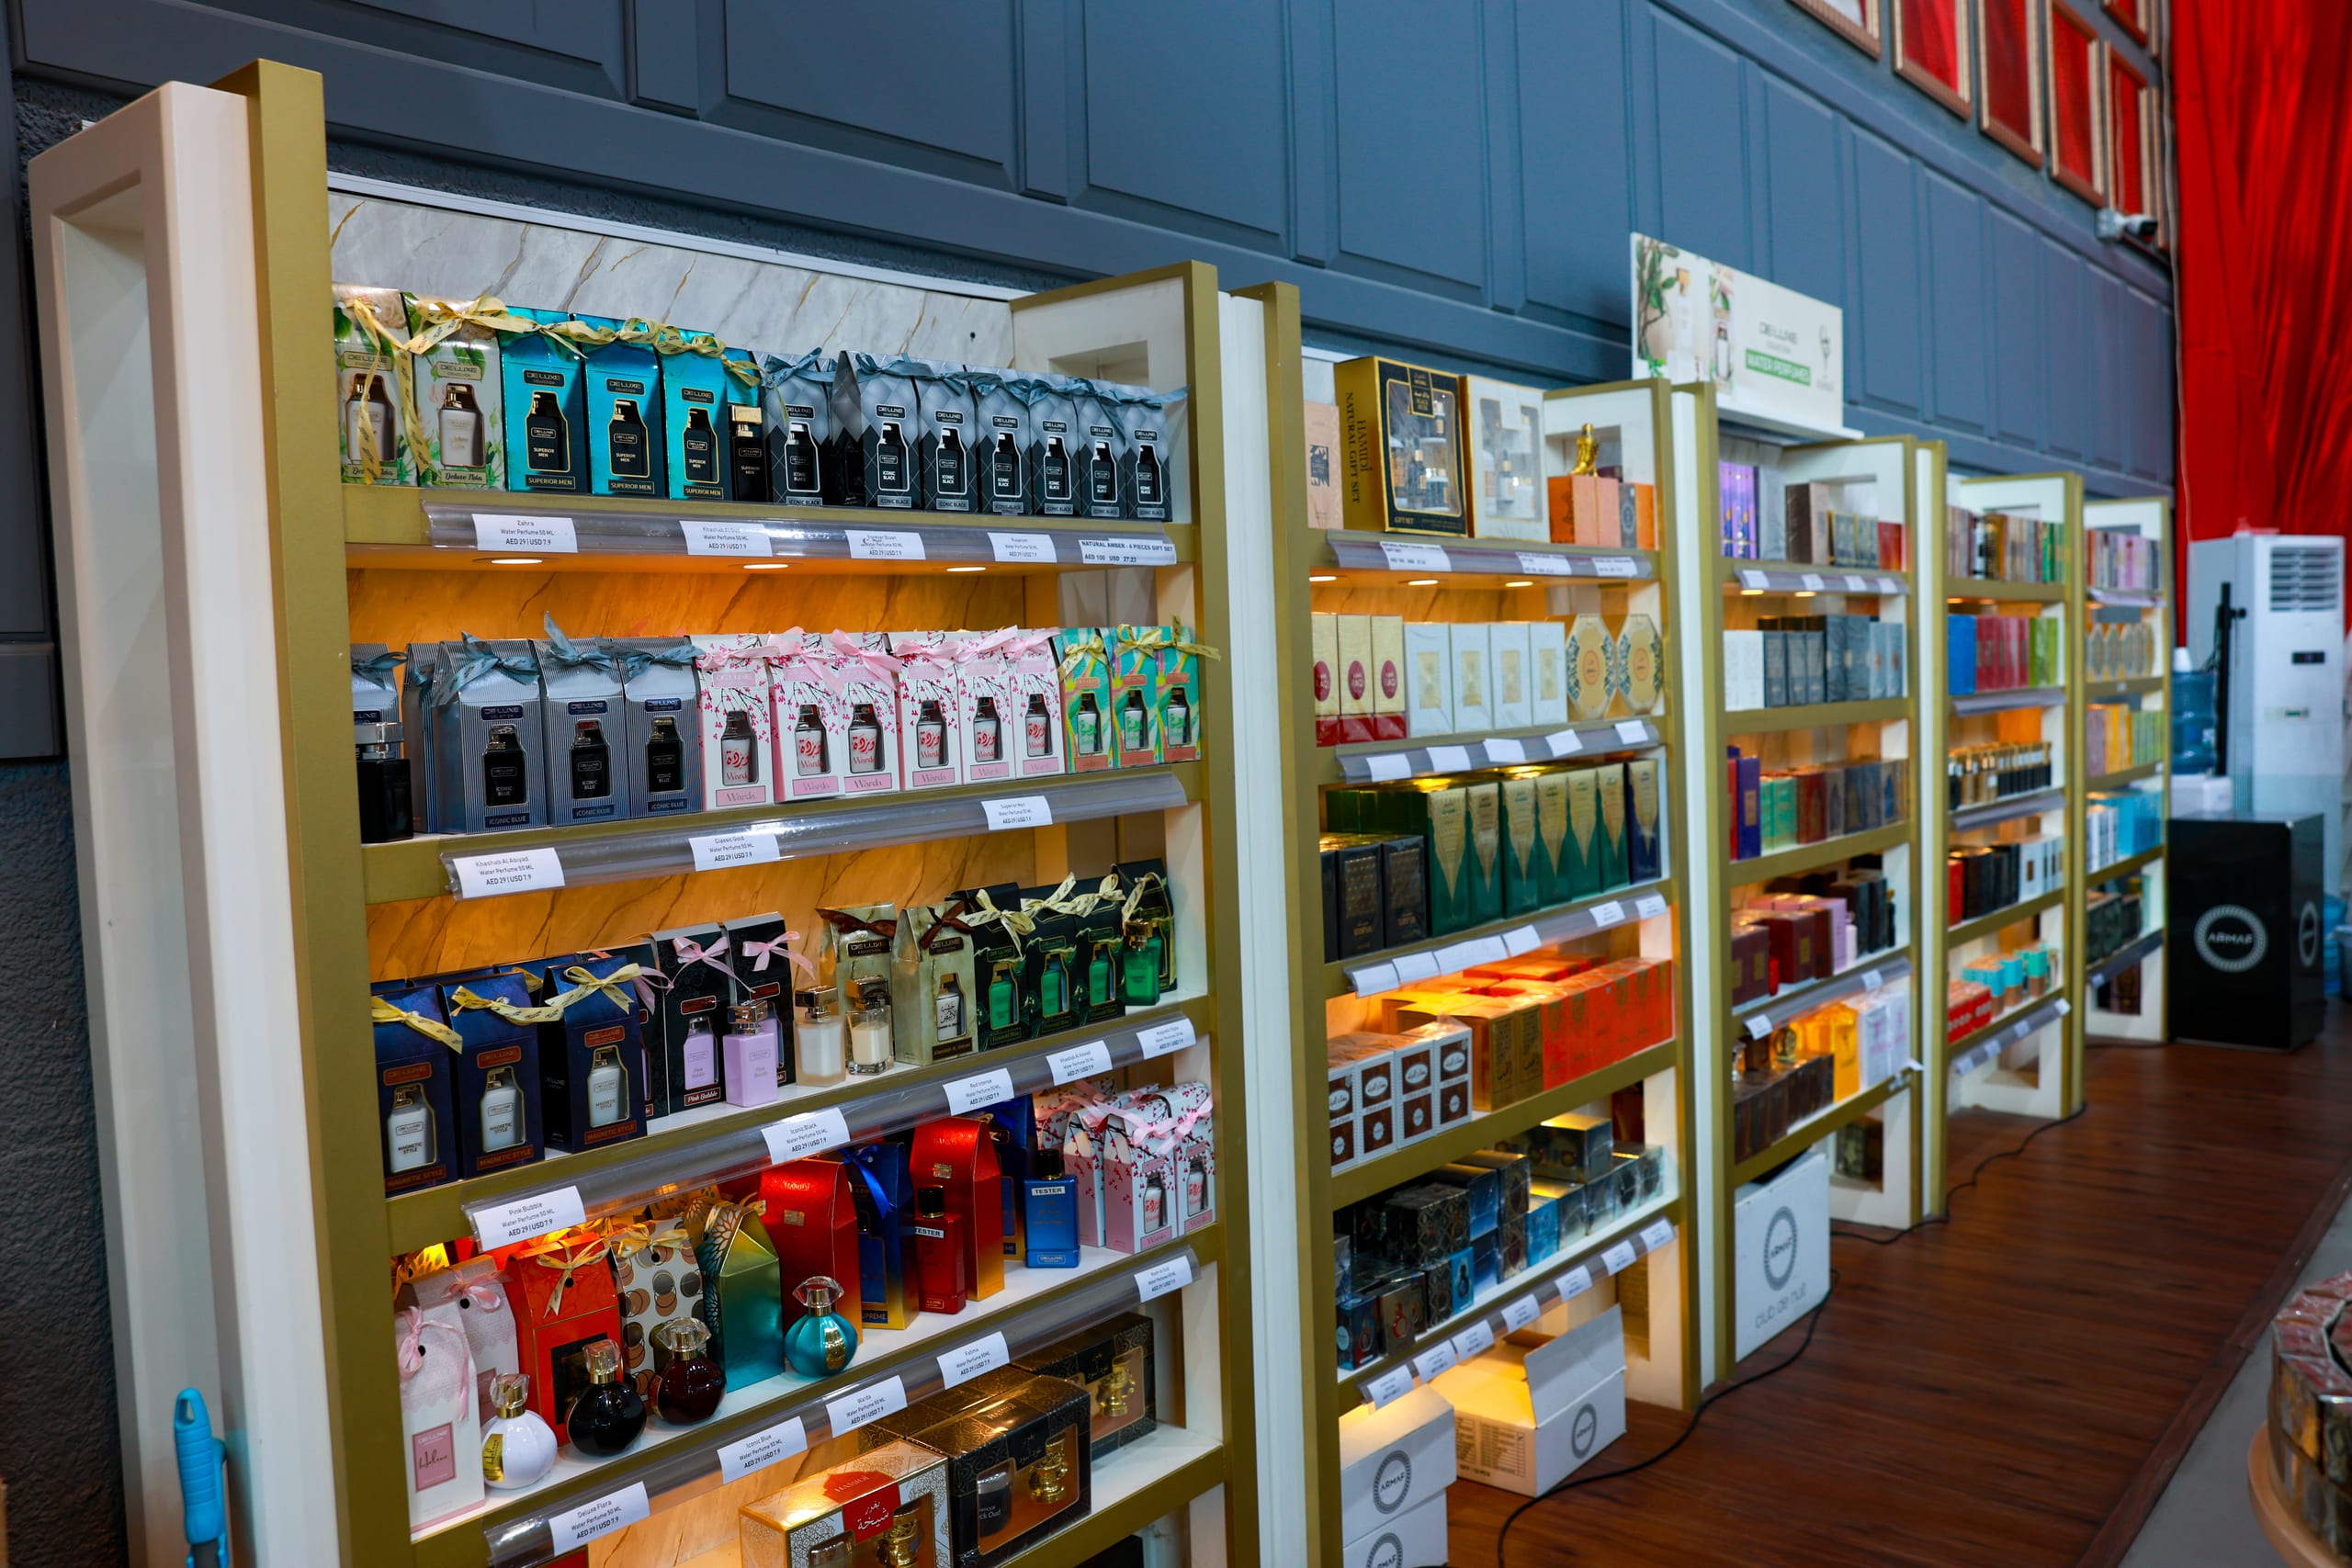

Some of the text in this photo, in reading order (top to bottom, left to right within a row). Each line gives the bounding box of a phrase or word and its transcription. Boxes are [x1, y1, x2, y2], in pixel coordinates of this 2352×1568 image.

[1345, 391, 1361, 504] NATURAL GIFT SET
[528, 477, 558, 485] SUPERIOR
[671, 800, 684, 808] BLUE
[576, 807, 611, 818] ICONIC BLUE
[489, 814, 527, 826] ICONIC BLUE
[2208, 931, 2254, 945] ARMAF
[687, 1089, 719, 1102] Pink Bubble
[586, 1124, 635, 1141] MAGNETIC STYLE
[398, 1141, 424, 1151] MAGNETIC
[402, 1146, 418, 1155] STYLE
[480, 1148, 531, 1166] MAGNETIC STYLE
[387, 1169, 443, 1188] MAGNETIC STYLE
[522, 1202, 543, 1213] Bubble
[517, 1214, 539, 1223] Perfume
[508, 1227, 521, 1236] AED
[915, 1227, 941, 1237] TESTER
[745, 1434, 772, 1449] Iconic Blue
[744, 1460, 754, 1469] AED
[1380, 1474, 1405, 1493] ARMAF
[577, 1500, 612, 1518] Deluxe Flora
[586, 1512, 607, 1523] Perfume
[576, 1529, 589, 1540] AED
[1377, 1554, 1396, 1568] RMAF
